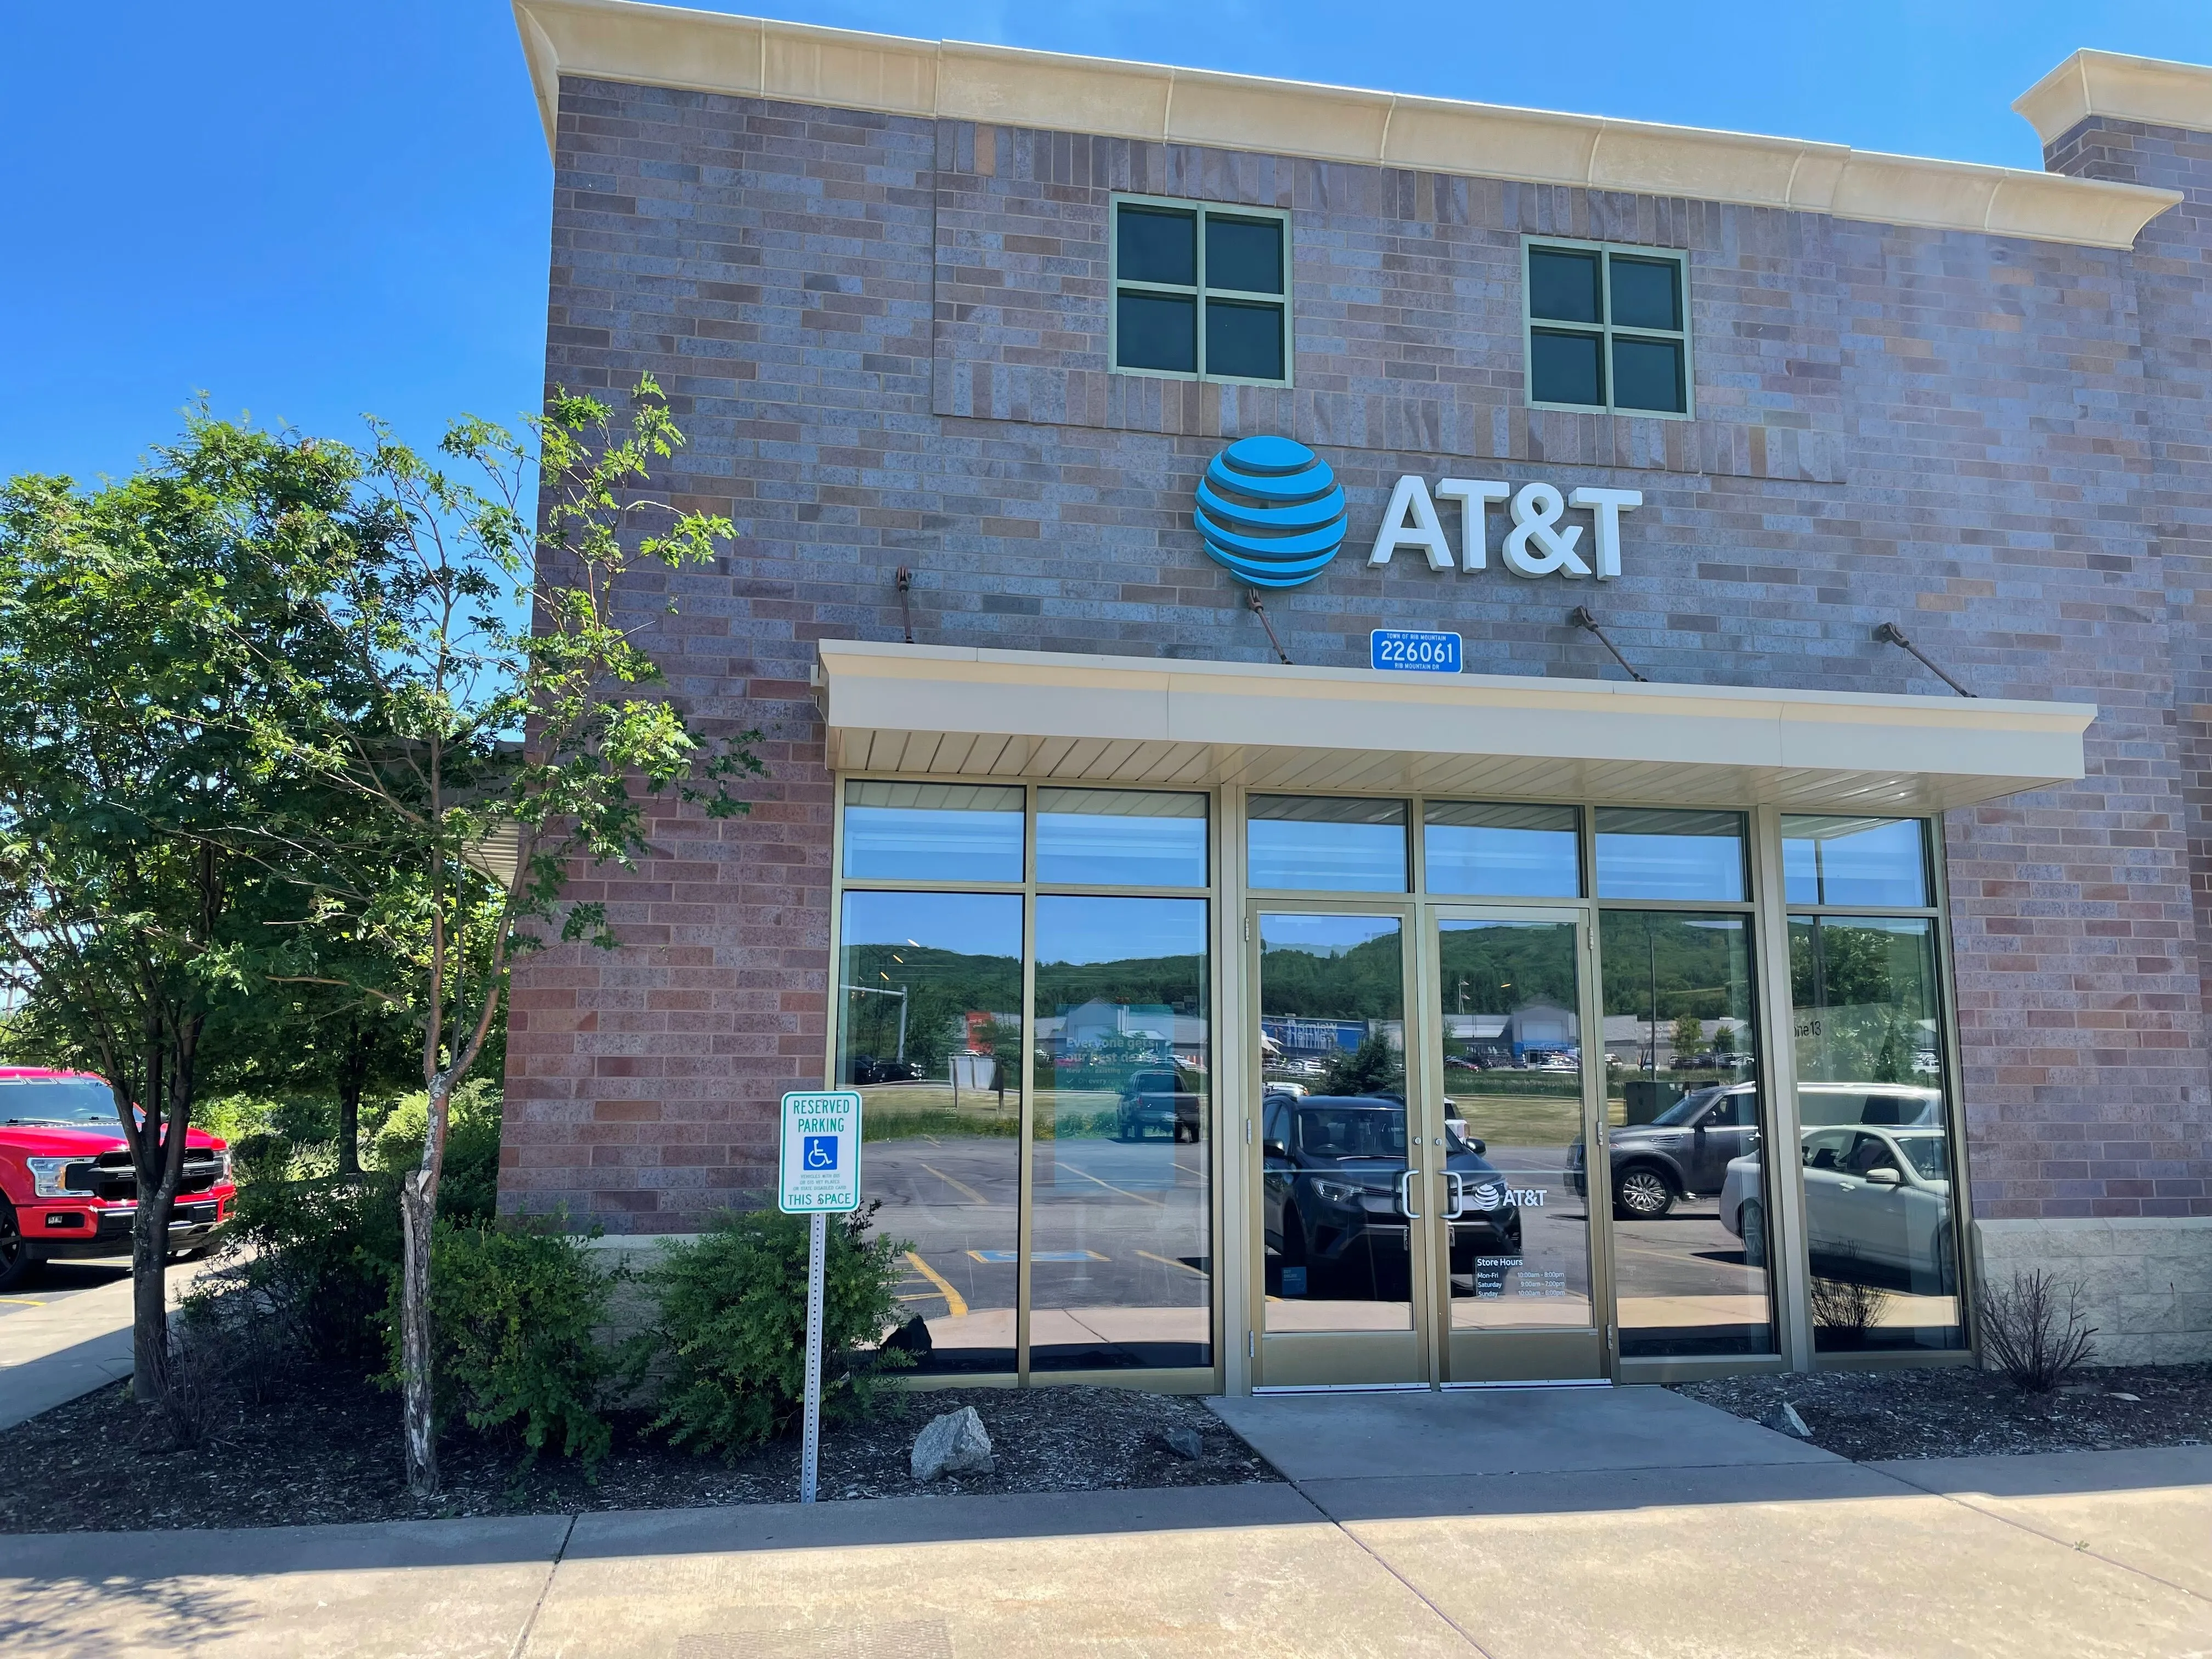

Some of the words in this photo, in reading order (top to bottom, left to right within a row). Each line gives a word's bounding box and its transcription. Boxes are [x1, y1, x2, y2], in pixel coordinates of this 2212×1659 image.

[1367, 475, 1643, 581] AT&T
[1381, 640, 1453, 663] 226061
[1810, 1020, 1821, 1036] 13
[1066, 1037, 1124, 1049] Everyone
[1127, 1038, 1155, 1049] gets
[1066, 1053, 1087, 1062] our
[1090, 1051, 1118, 1062] best
[793, 1099, 850, 1114] RESERVED
[798, 1118, 844, 1132] PARKING
[788, 1194, 812, 1205] THIS
[817, 1193, 851, 1205] SPACE
[1503, 1189, 1548, 1206] AT&T
[1477, 1258, 1498, 1266] Store
[1499, 1258, 1523, 1266] Hours
